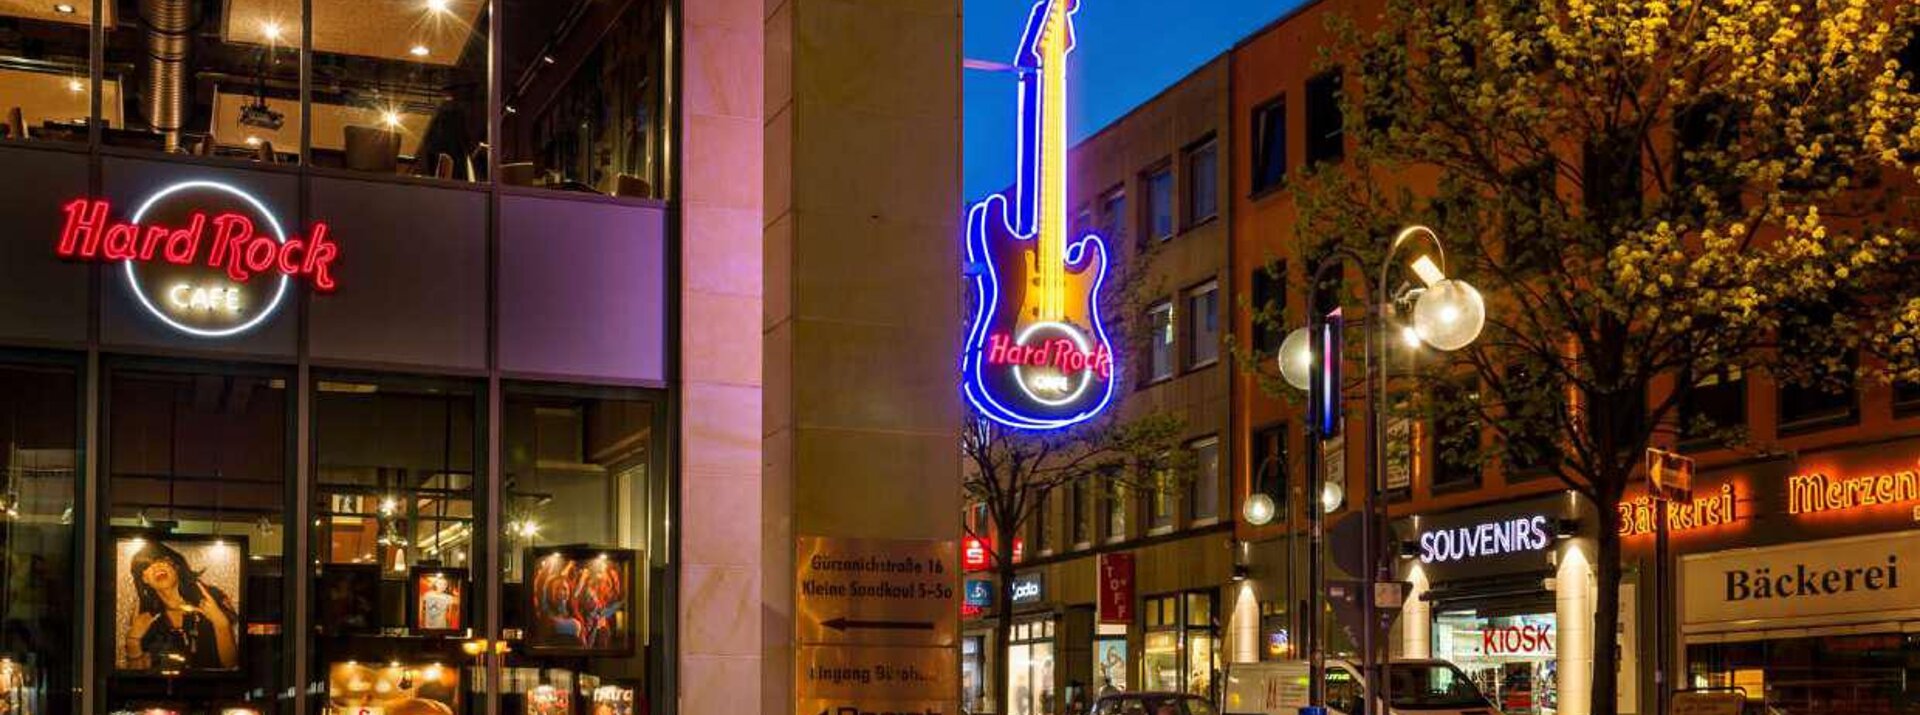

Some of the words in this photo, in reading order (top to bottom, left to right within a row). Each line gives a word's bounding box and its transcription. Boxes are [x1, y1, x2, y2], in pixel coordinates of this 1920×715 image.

[58, 199, 206, 264] Hard
[207, 212, 338, 289] Rock
[168, 283, 241, 310] CAFE
[988, 333, 1050, 366] Hard
[1053, 338, 1110, 378] Rock
[1788, 468, 1920, 514] Merzen
[1420, 515, 1547, 564] SOUVENIRS
[802, 579, 845, 597] Kleine
[928, 559, 944, 574] 16
[1724, 554, 1899, 602] Bäckerei
[1483, 624, 1553, 655] KIOSK
